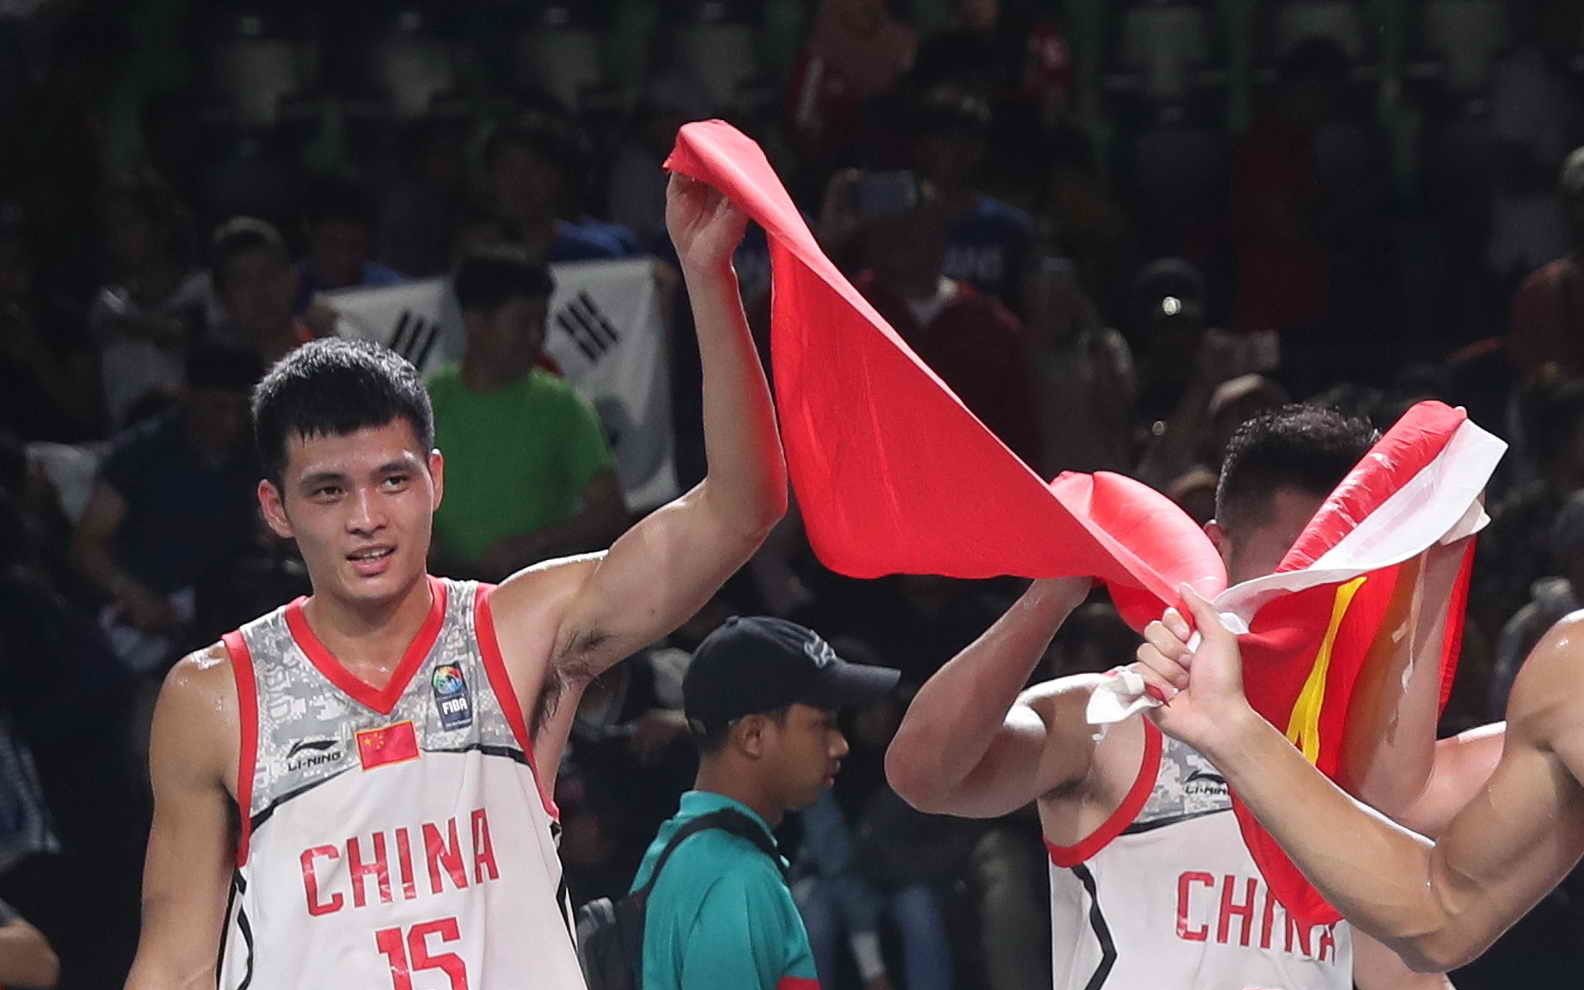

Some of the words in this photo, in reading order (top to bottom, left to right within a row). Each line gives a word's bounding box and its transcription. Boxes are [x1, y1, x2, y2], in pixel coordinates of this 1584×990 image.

[287, 751, 341, 772] LI-NING
[1185, 786, 1228, 796] LI-NIN
[300, 808, 501, 917] CHINA
